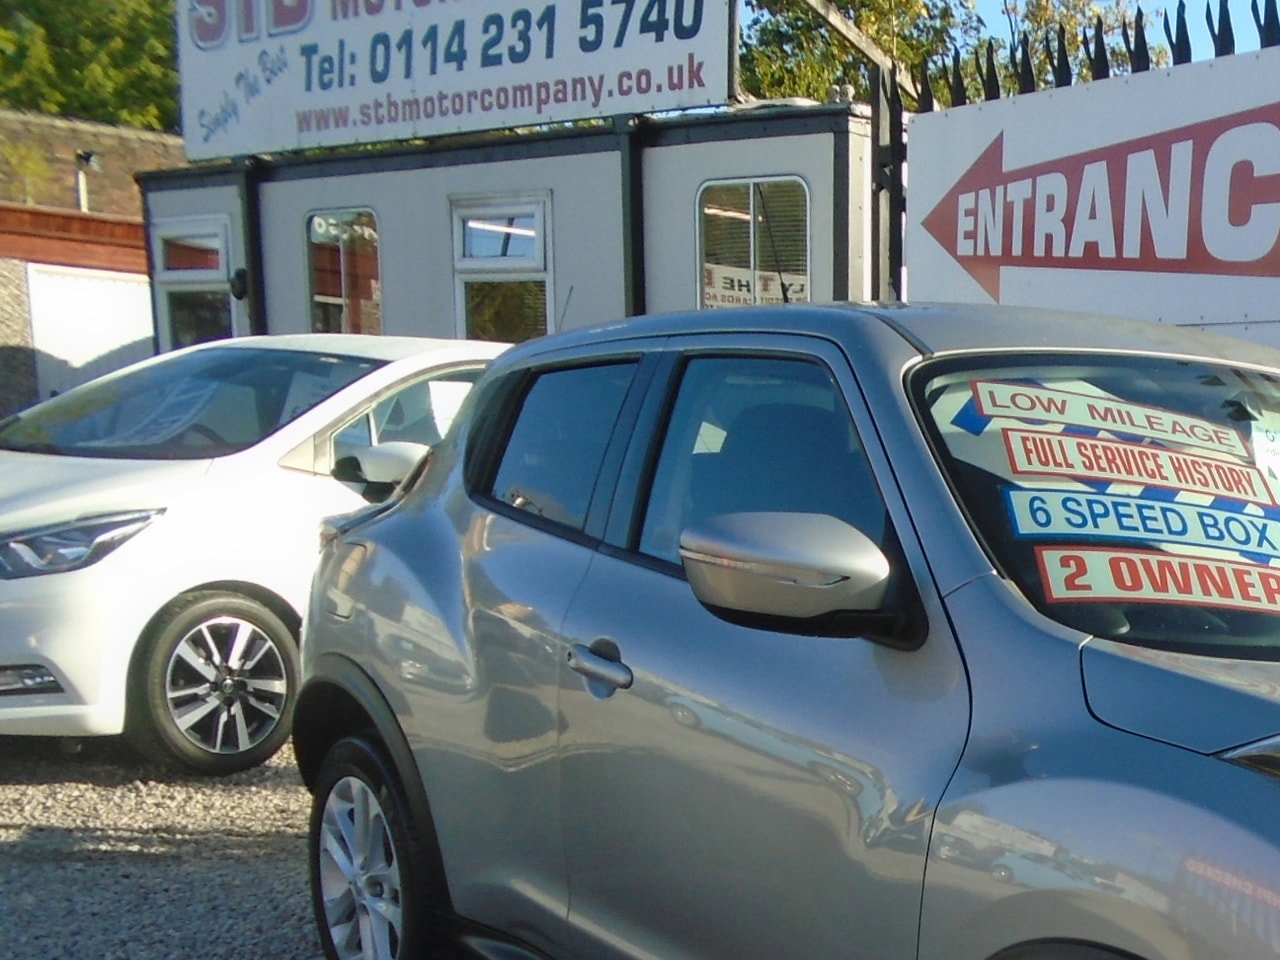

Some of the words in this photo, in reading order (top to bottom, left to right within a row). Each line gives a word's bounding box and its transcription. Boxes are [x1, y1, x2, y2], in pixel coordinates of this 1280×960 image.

[300, 38, 356, 92] Tel:
[369, 20, 468, 84] 0114
[480, 4, 557, 69] 231
[578, 0, 704, 53] 5740
[296, 52, 706, 133] www.stbmotorcompany.co.uk
[987, 389, 1067, 417] LOW
[1086, 402, 1237, 449] MILEAGE
[1021, 434, 1075, 470] FULL
[1076, 440, 1167, 481] SERVICE
[1168, 455, 1259, 498] HISTORY
[1028, 495, 1052, 528] 6
[1061, 496, 1189, 537] SPEED
[1196, 510, 1280, 552] BOX
[1060, 554, 1092, 592] 2
